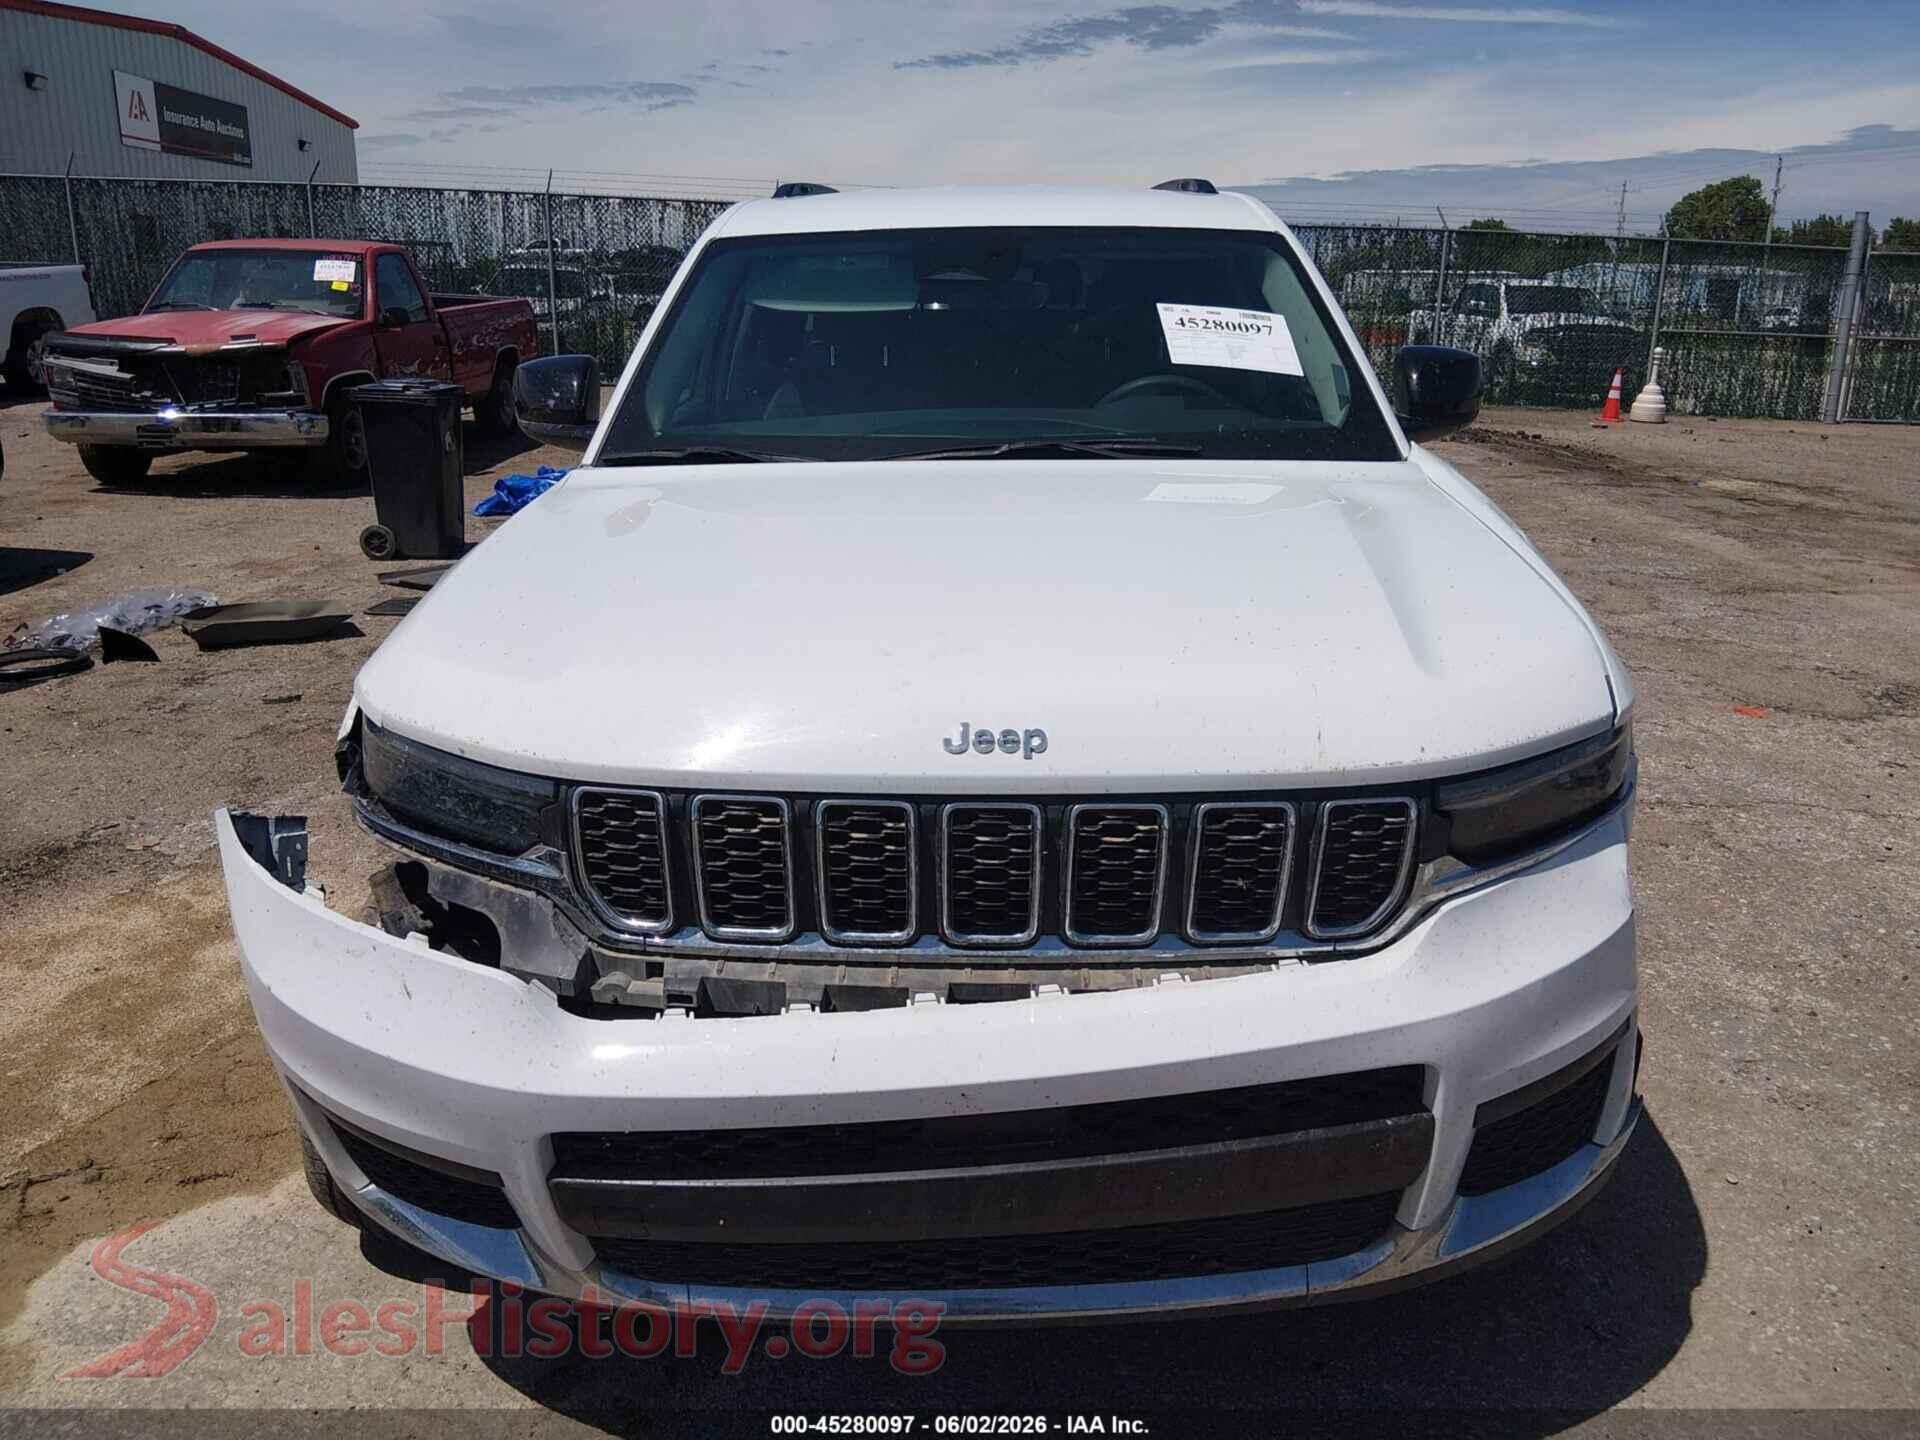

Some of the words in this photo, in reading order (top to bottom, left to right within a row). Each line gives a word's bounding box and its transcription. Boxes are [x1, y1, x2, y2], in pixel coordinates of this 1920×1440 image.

[163, 106, 199, 127] Insurance
[200, 115, 216, 131] Auto
[216, 119, 245, 139] Auctions
[1174, 316, 1273, 336] 45280097
[943, 722, 1049, 760] Jeep
